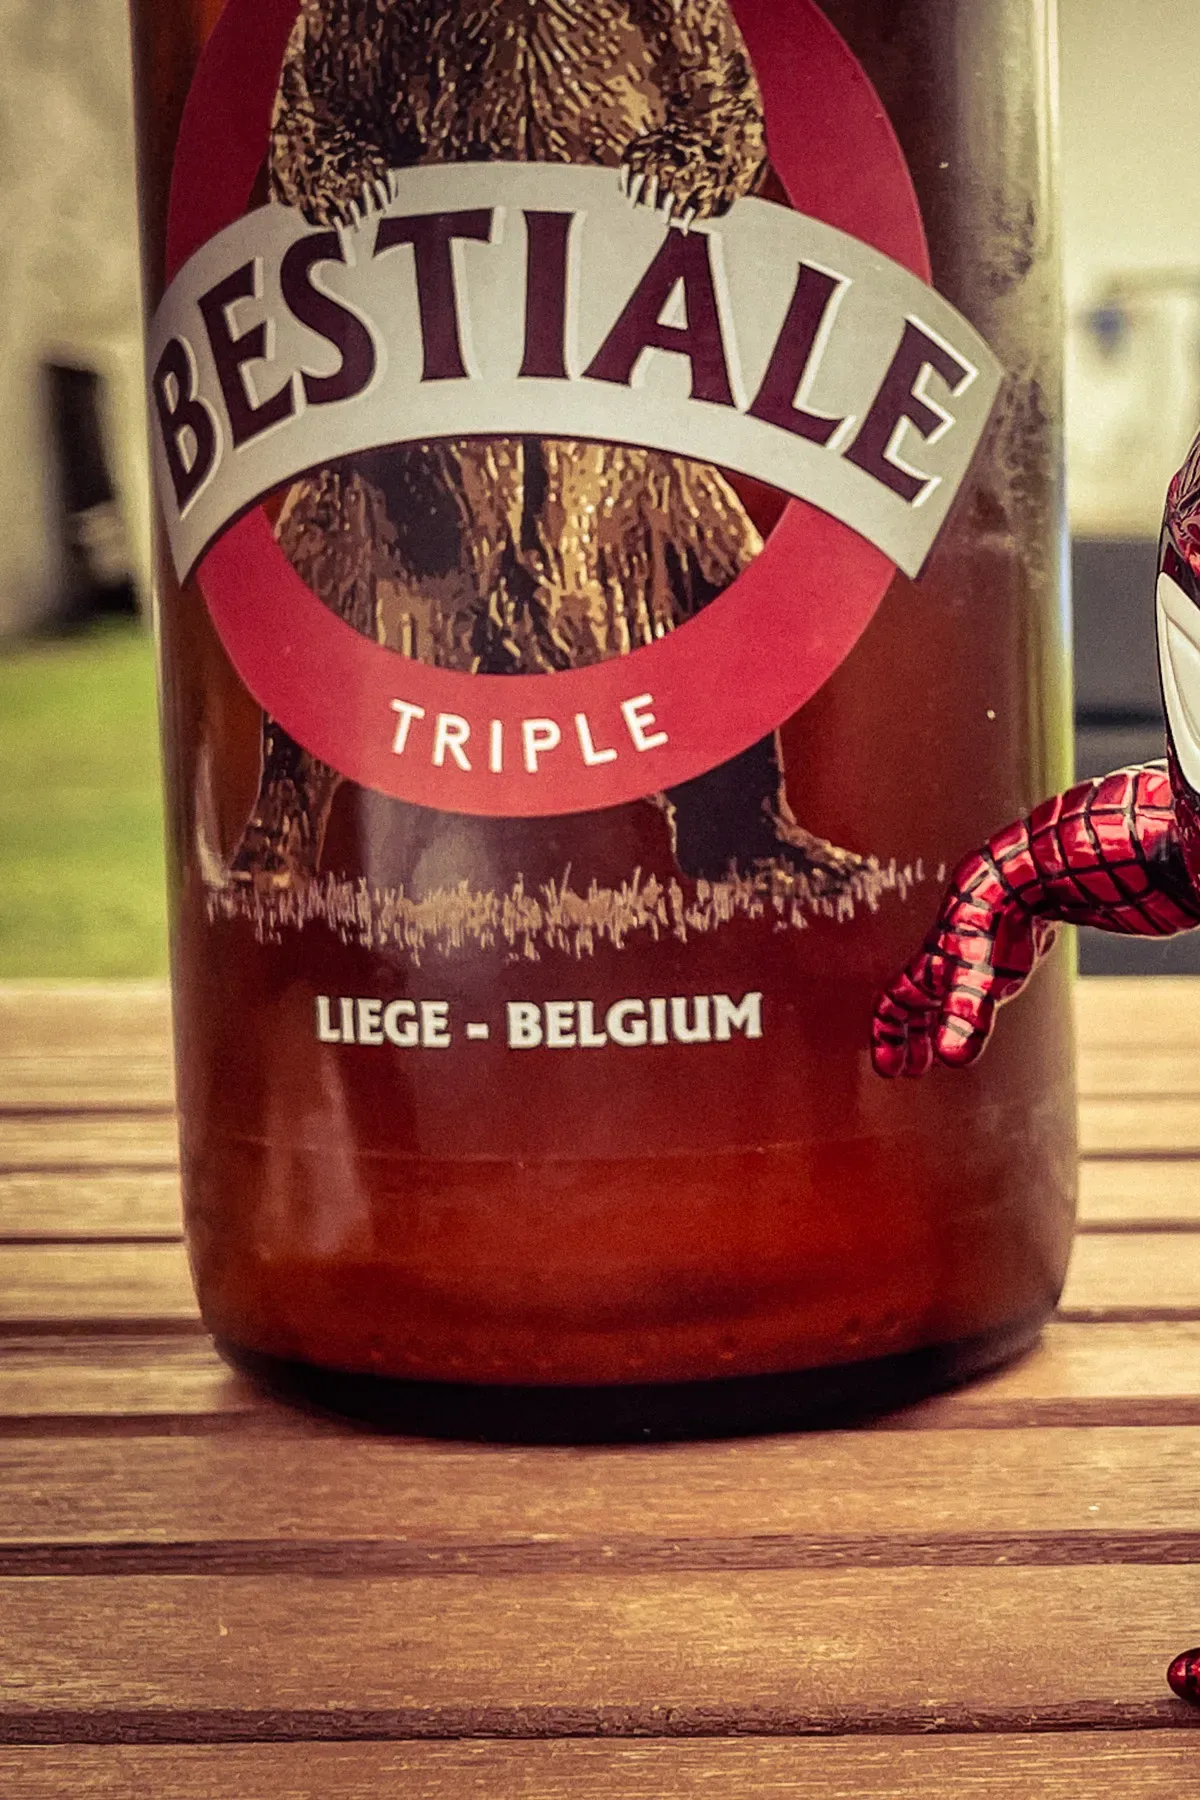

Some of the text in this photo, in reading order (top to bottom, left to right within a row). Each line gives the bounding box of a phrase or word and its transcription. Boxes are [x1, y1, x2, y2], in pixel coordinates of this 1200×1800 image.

[152, 206, 979, 520] BESTIALE
[390, 693, 668, 773] TRIPLE
[316, 995, 451, 1048] LIEGE
[506, 992, 764, 1049] BELGIUM
